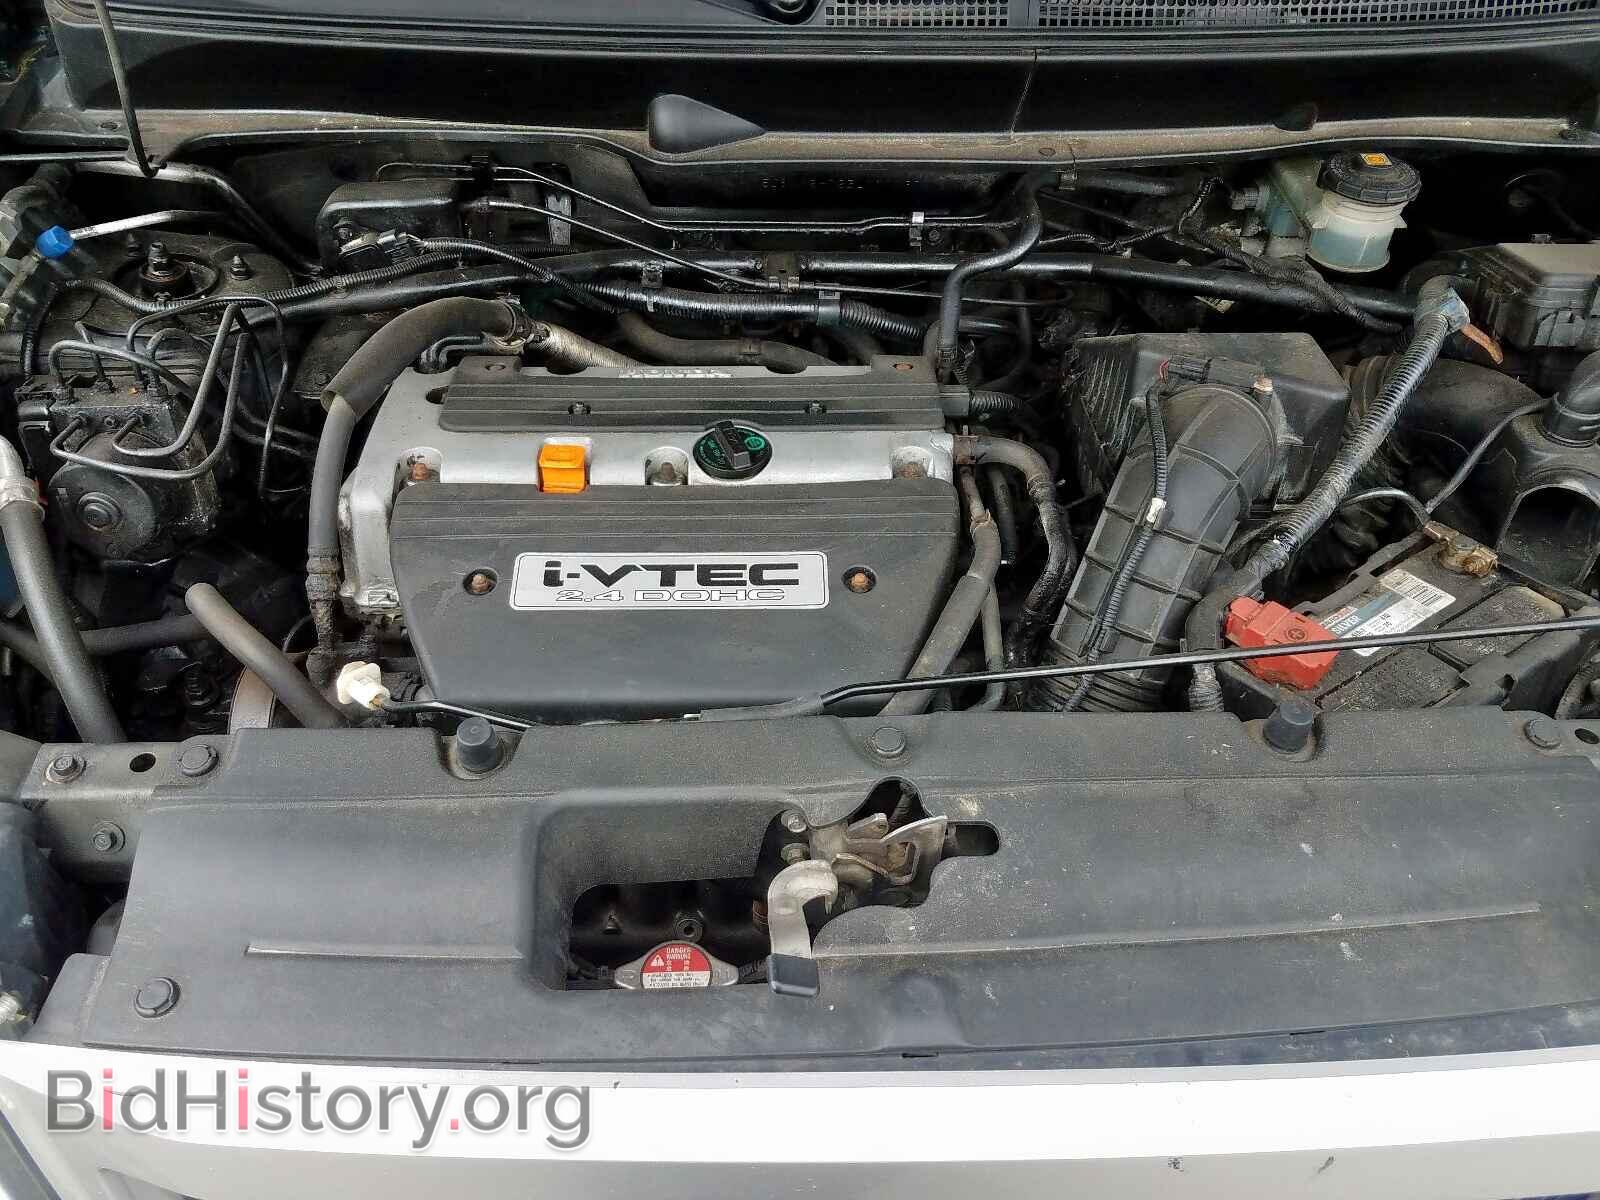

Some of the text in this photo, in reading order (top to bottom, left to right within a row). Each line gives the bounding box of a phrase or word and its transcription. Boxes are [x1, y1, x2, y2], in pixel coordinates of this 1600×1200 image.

[543, 560, 799, 587] i-VTEC
[555, 589, 784, 602] 2.4 DOHC
[1331, 615, 1362, 634] SILVER
